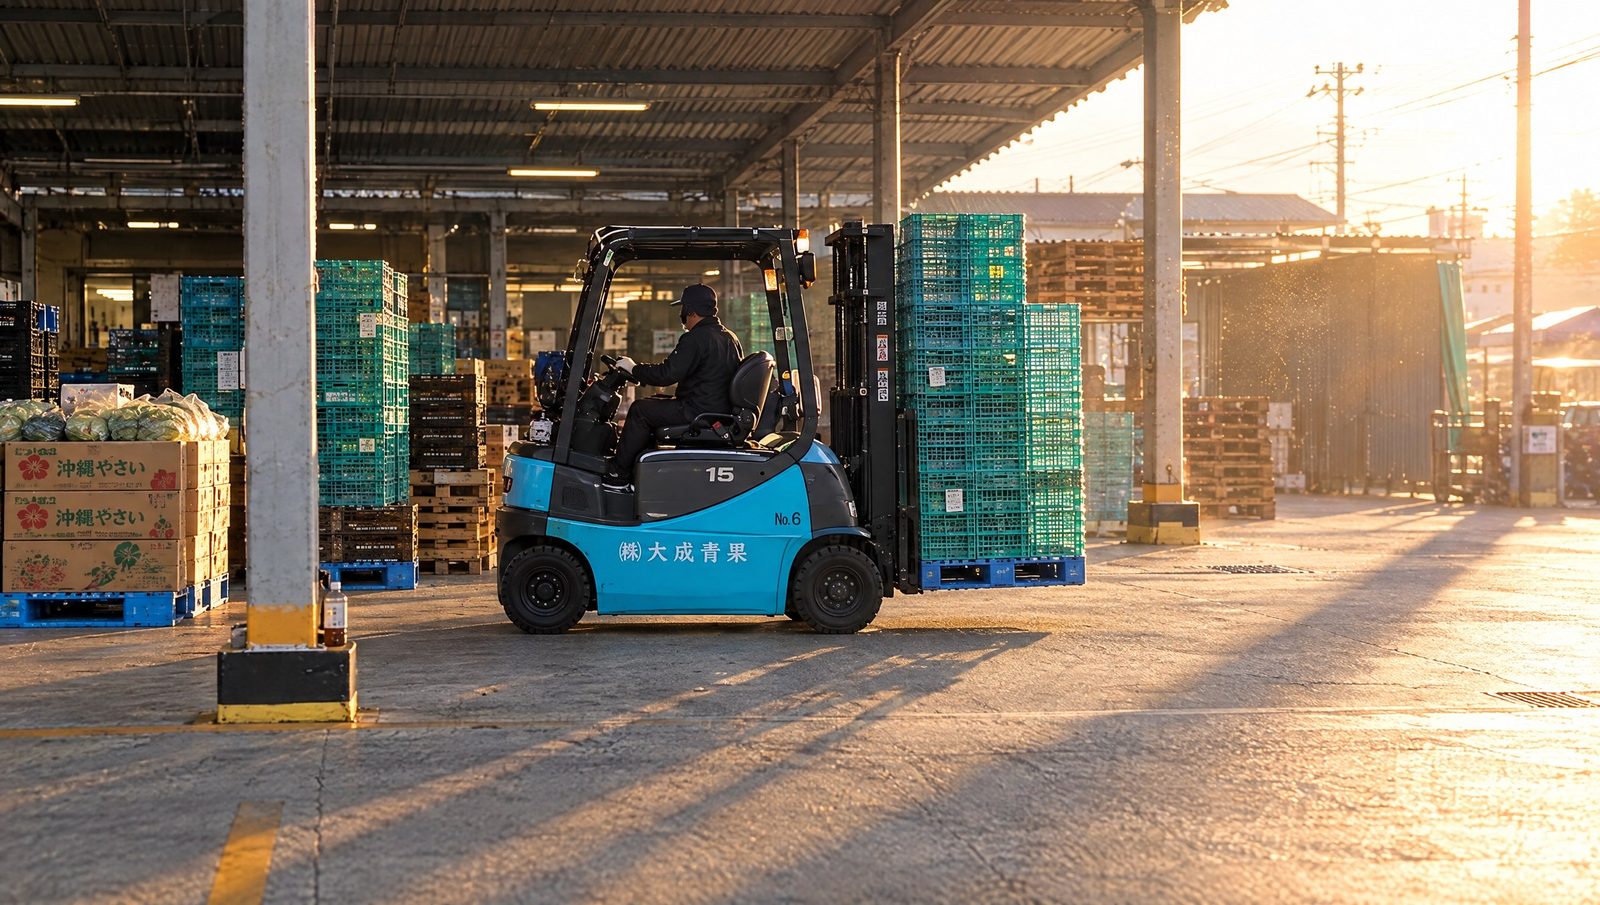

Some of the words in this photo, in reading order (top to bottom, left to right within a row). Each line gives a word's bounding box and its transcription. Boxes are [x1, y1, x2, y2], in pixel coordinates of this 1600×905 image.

[57, 459, 145, 478] 沖縄やさい
[706, 466, 734, 482] 15
[56, 508, 145, 527] 沖縄やさい
